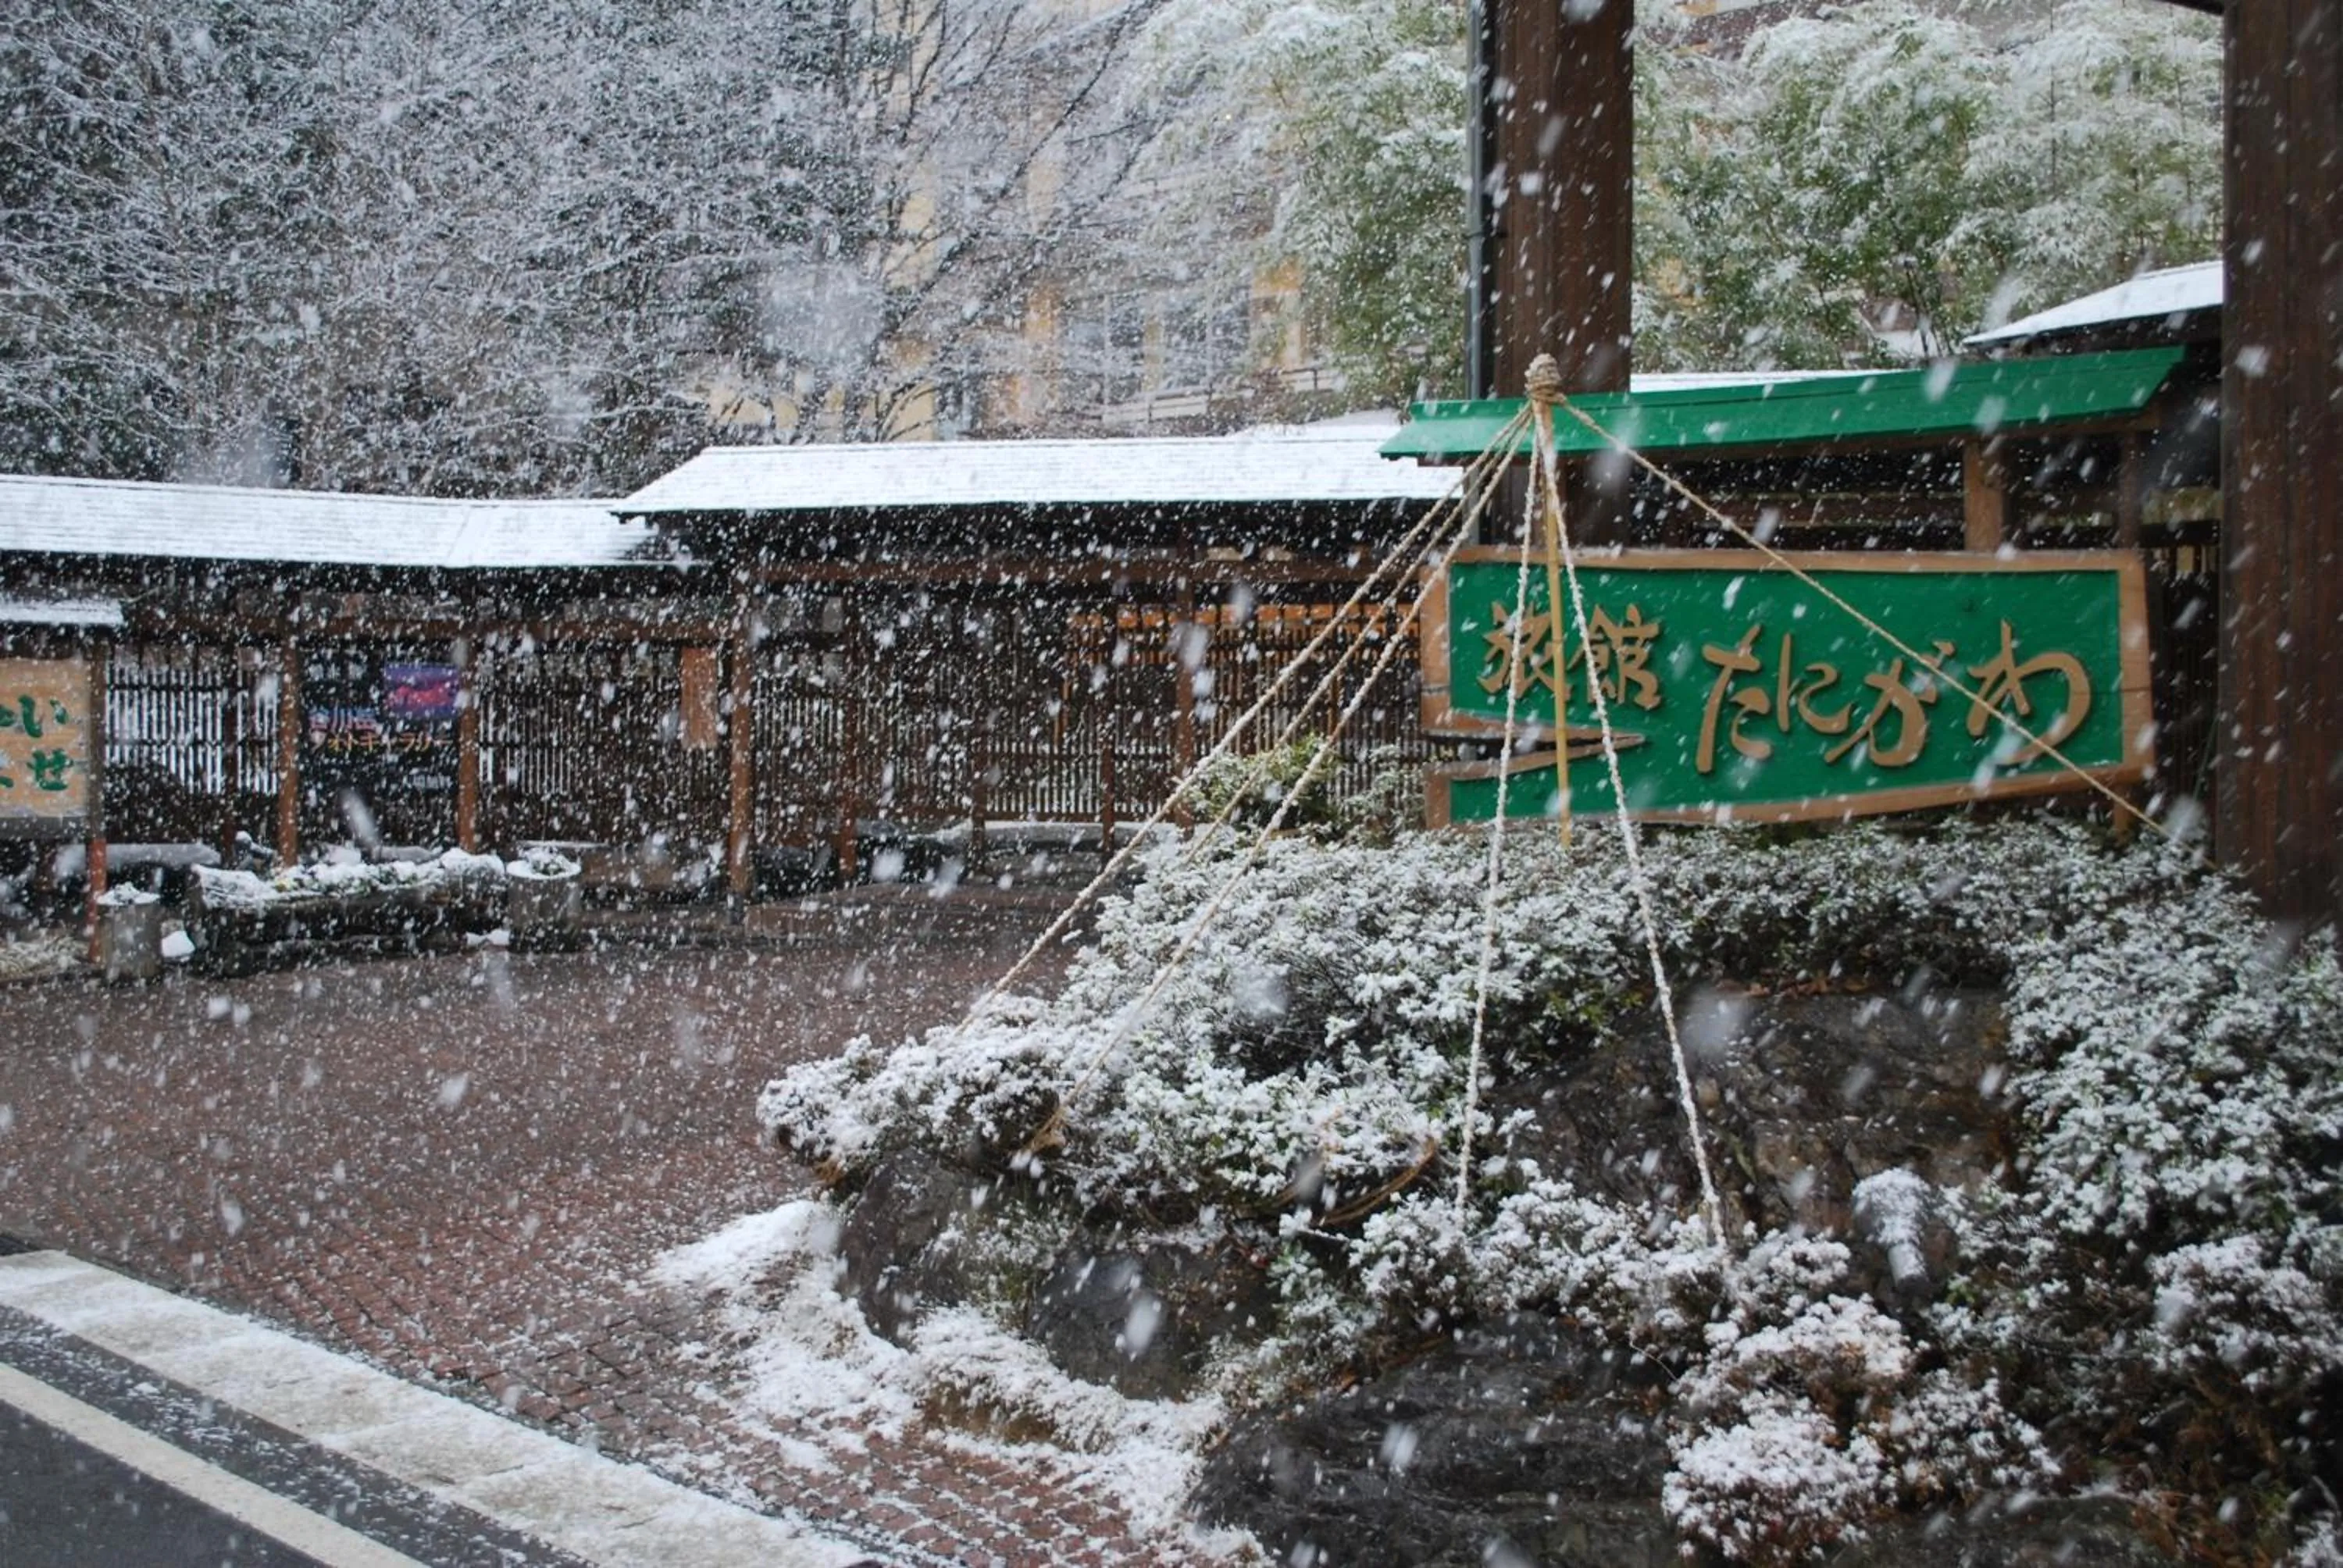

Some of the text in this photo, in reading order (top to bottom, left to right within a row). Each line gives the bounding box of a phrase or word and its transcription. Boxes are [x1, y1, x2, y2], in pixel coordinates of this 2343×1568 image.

[1476, 600, 2091, 773] 旅館 たにがわ
